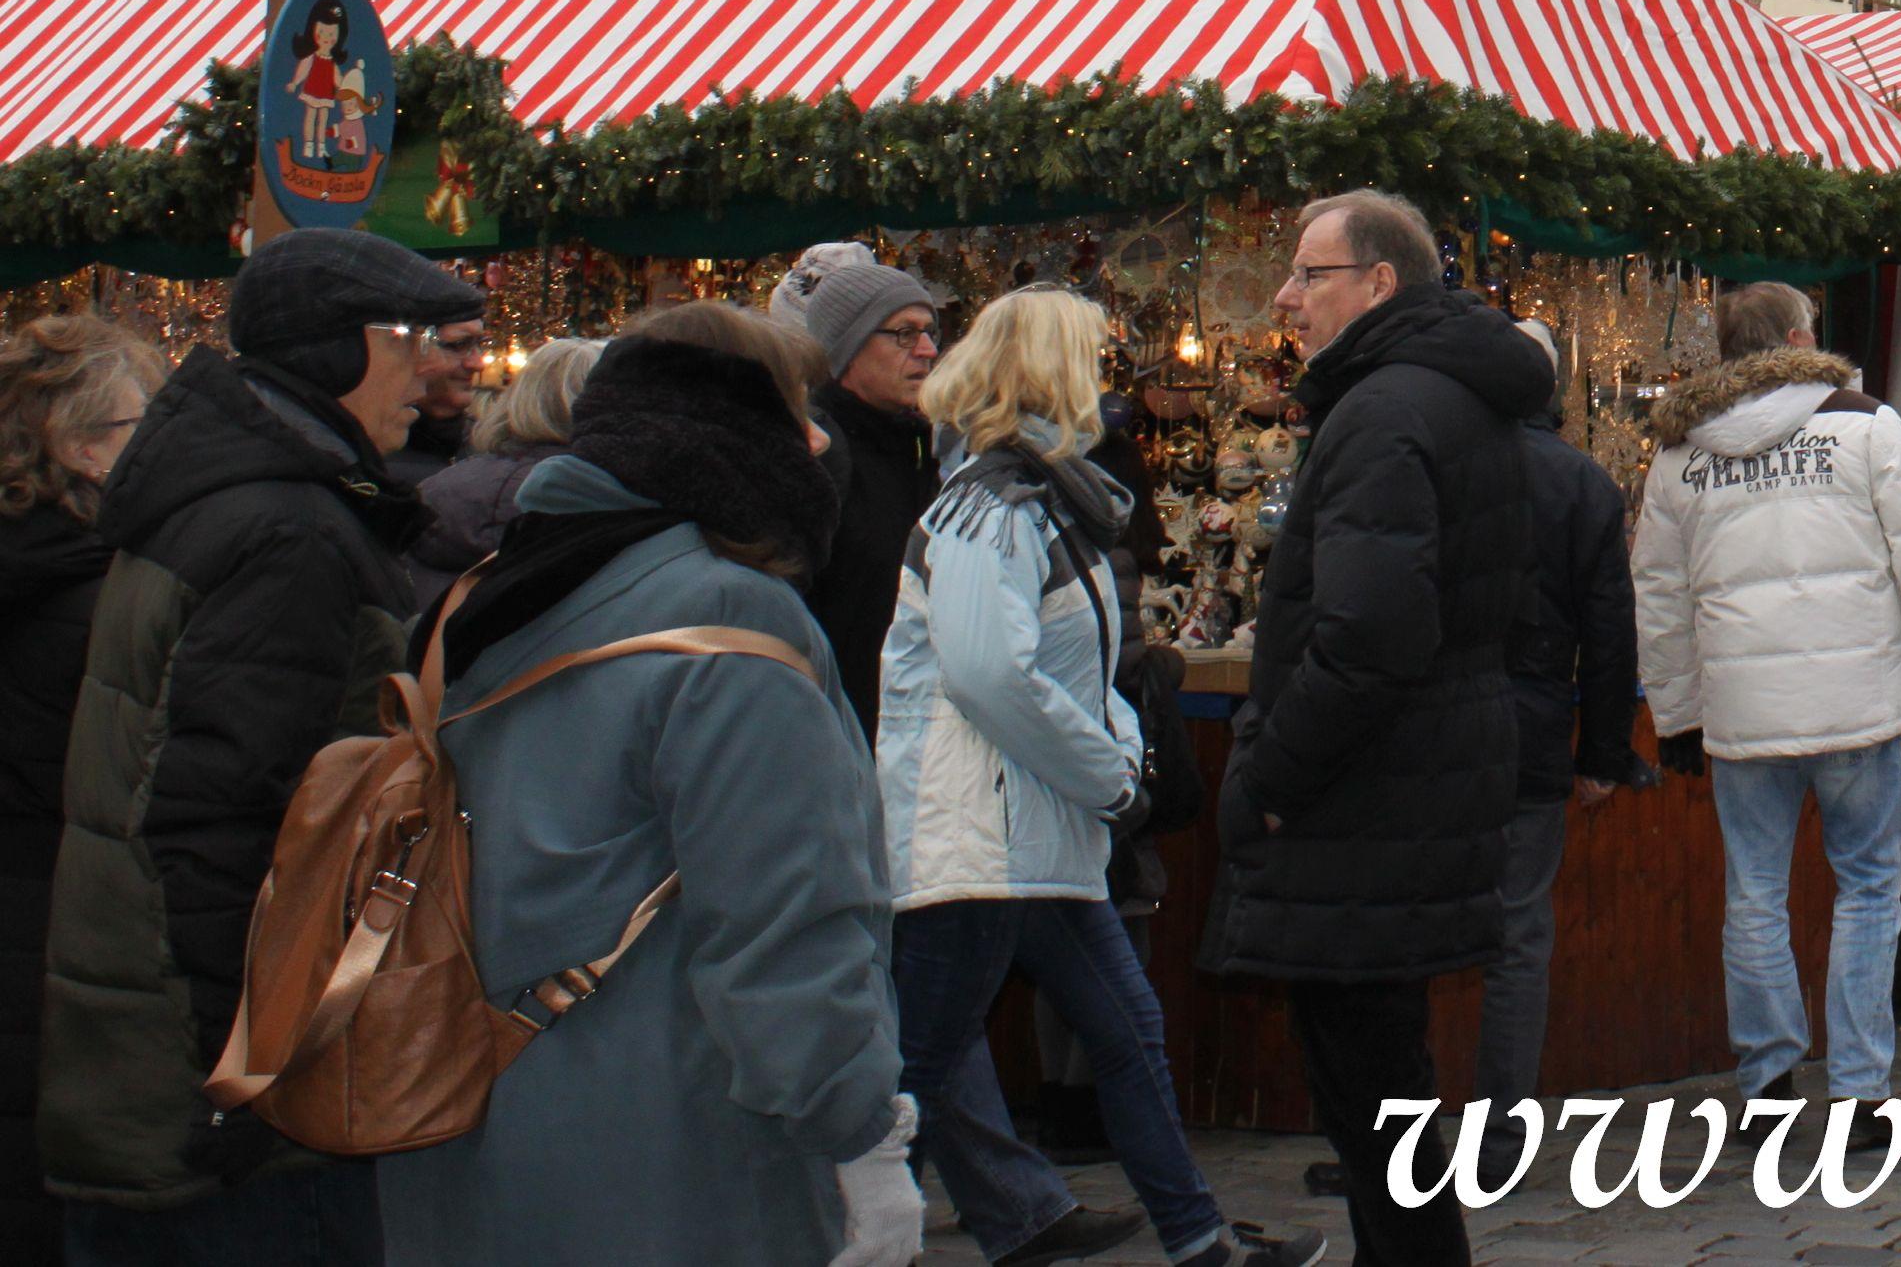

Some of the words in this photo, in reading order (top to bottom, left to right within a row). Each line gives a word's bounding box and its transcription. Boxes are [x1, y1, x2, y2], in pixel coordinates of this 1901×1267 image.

[1682, 425, 1840, 483] Extion
[1688, 447, 1833, 494] WILDLIFE
[1746, 477, 1781, 493] CAMP
[1790, 473, 1833, 487] DAVID
